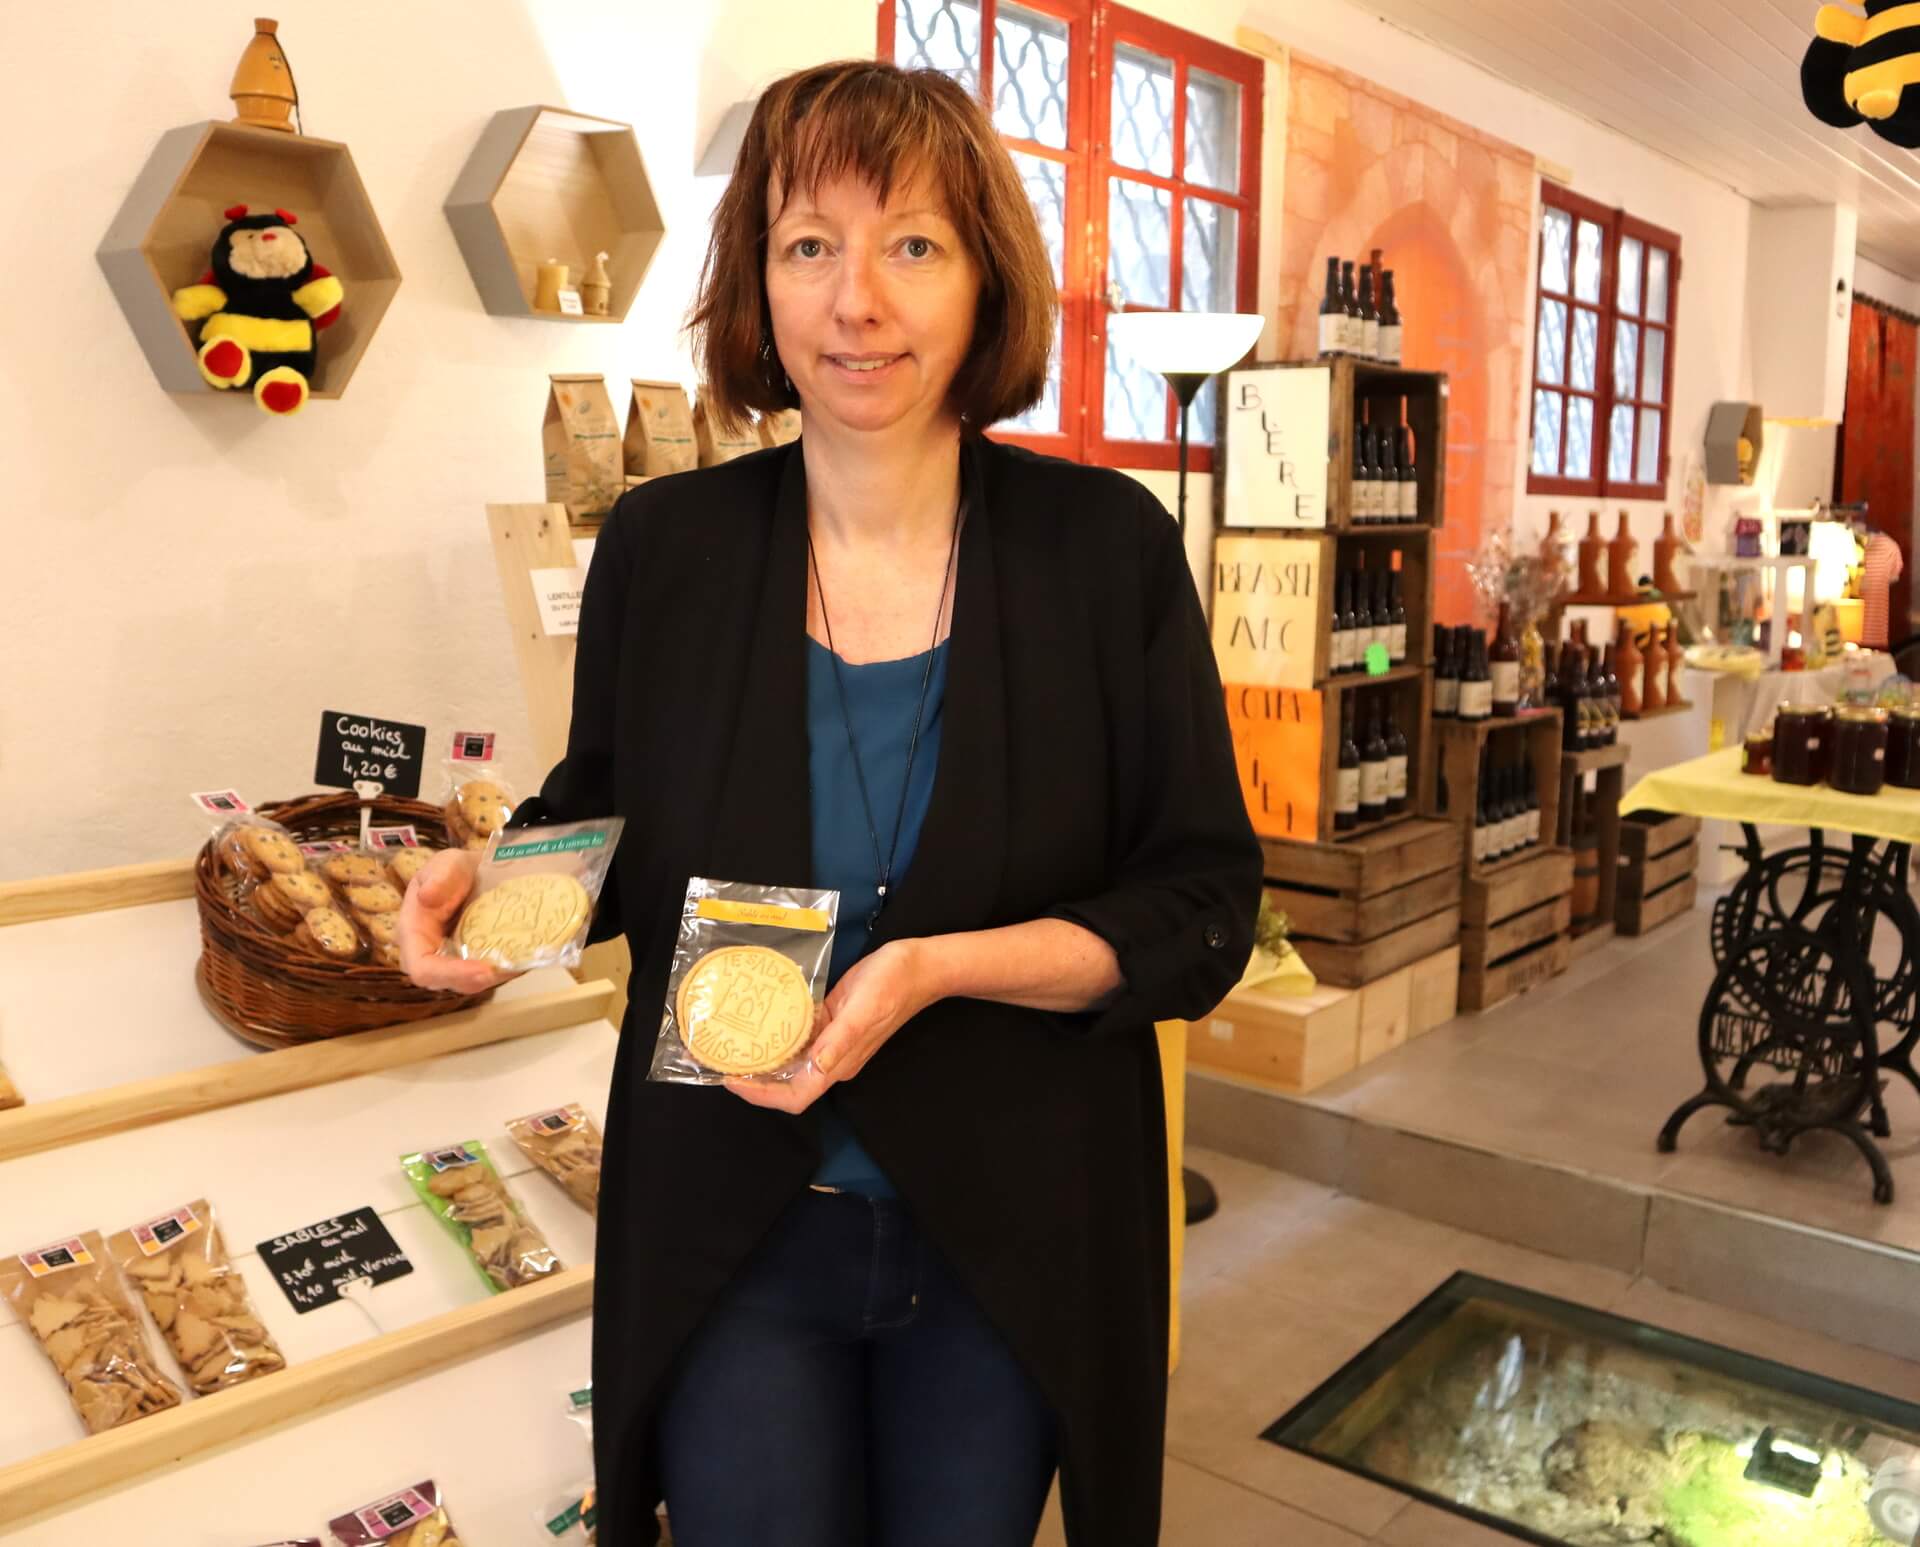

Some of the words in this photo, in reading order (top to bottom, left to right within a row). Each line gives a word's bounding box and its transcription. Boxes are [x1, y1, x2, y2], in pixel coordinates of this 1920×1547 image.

[546, 591, 583, 601] LENTILLE
[336, 716, 402, 745] Cookies
[341, 741, 365, 753] au
[371, 743, 411, 760] miel
